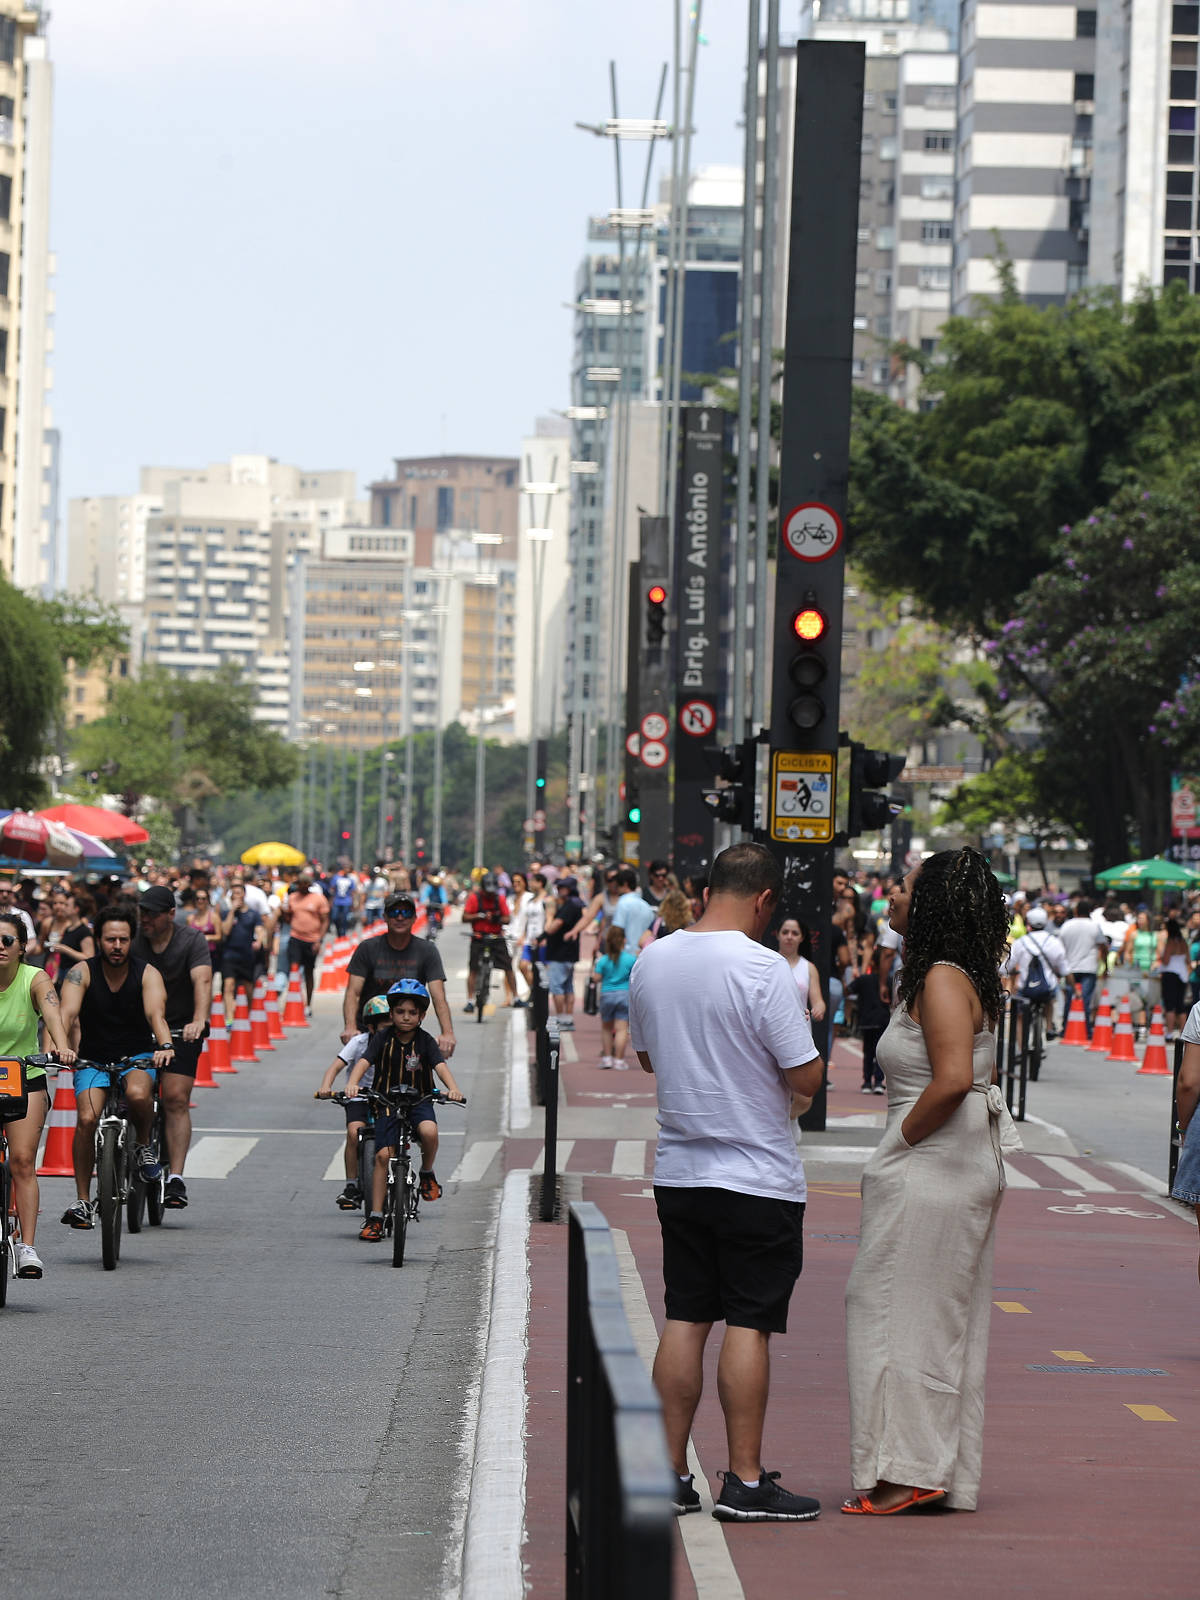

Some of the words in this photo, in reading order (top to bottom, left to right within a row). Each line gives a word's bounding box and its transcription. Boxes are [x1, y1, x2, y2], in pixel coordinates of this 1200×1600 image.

[686, 471, 709, 569] Antônio
[685, 575, 705, 626] Luís
[683, 631, 709, 687] Brig.
[780, 758, 829, 769] CICLISTA
